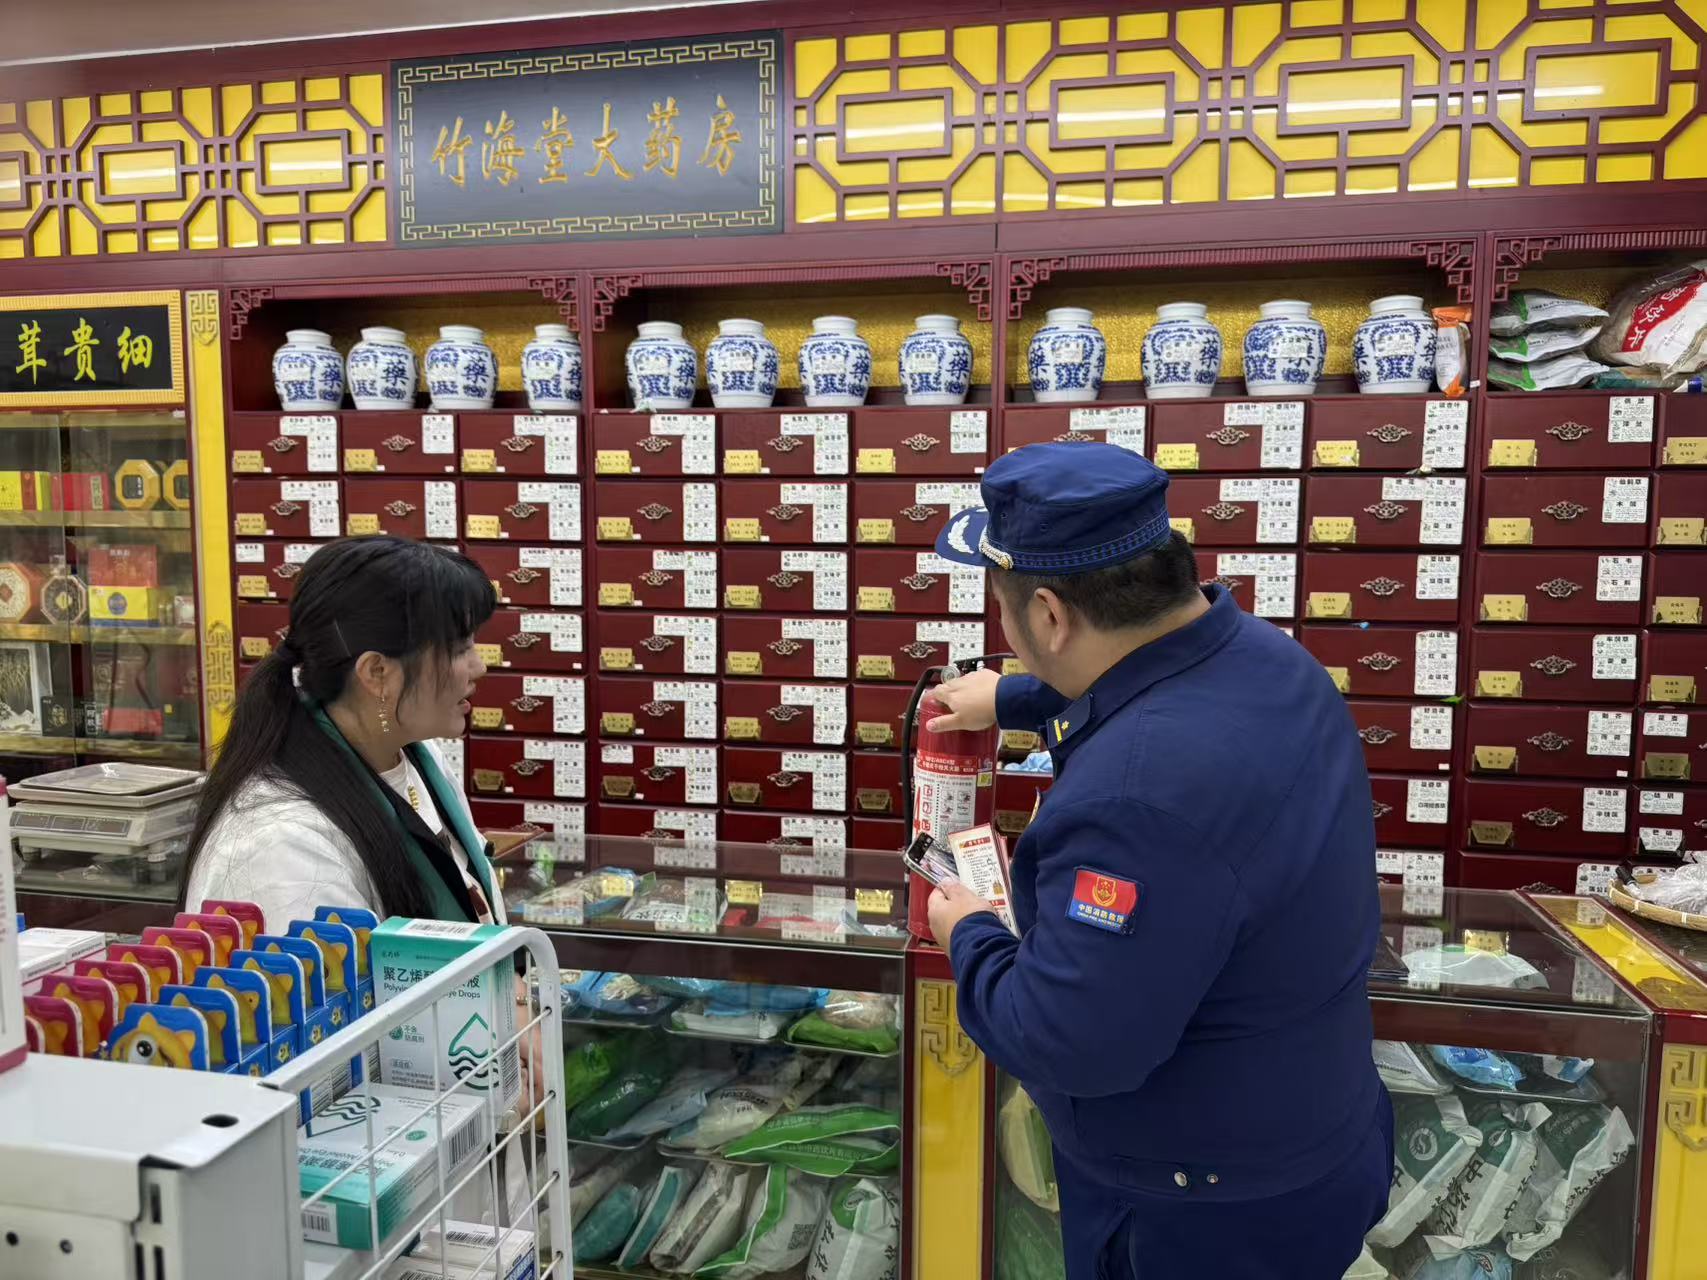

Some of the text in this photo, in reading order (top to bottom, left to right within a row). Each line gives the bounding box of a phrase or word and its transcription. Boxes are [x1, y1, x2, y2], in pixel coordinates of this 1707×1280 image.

[432, 93, 742, 187] 竹海堂大药房
[16, 317, 153, 385] 茸贵细
[458, 989, 481, 999] Drops
